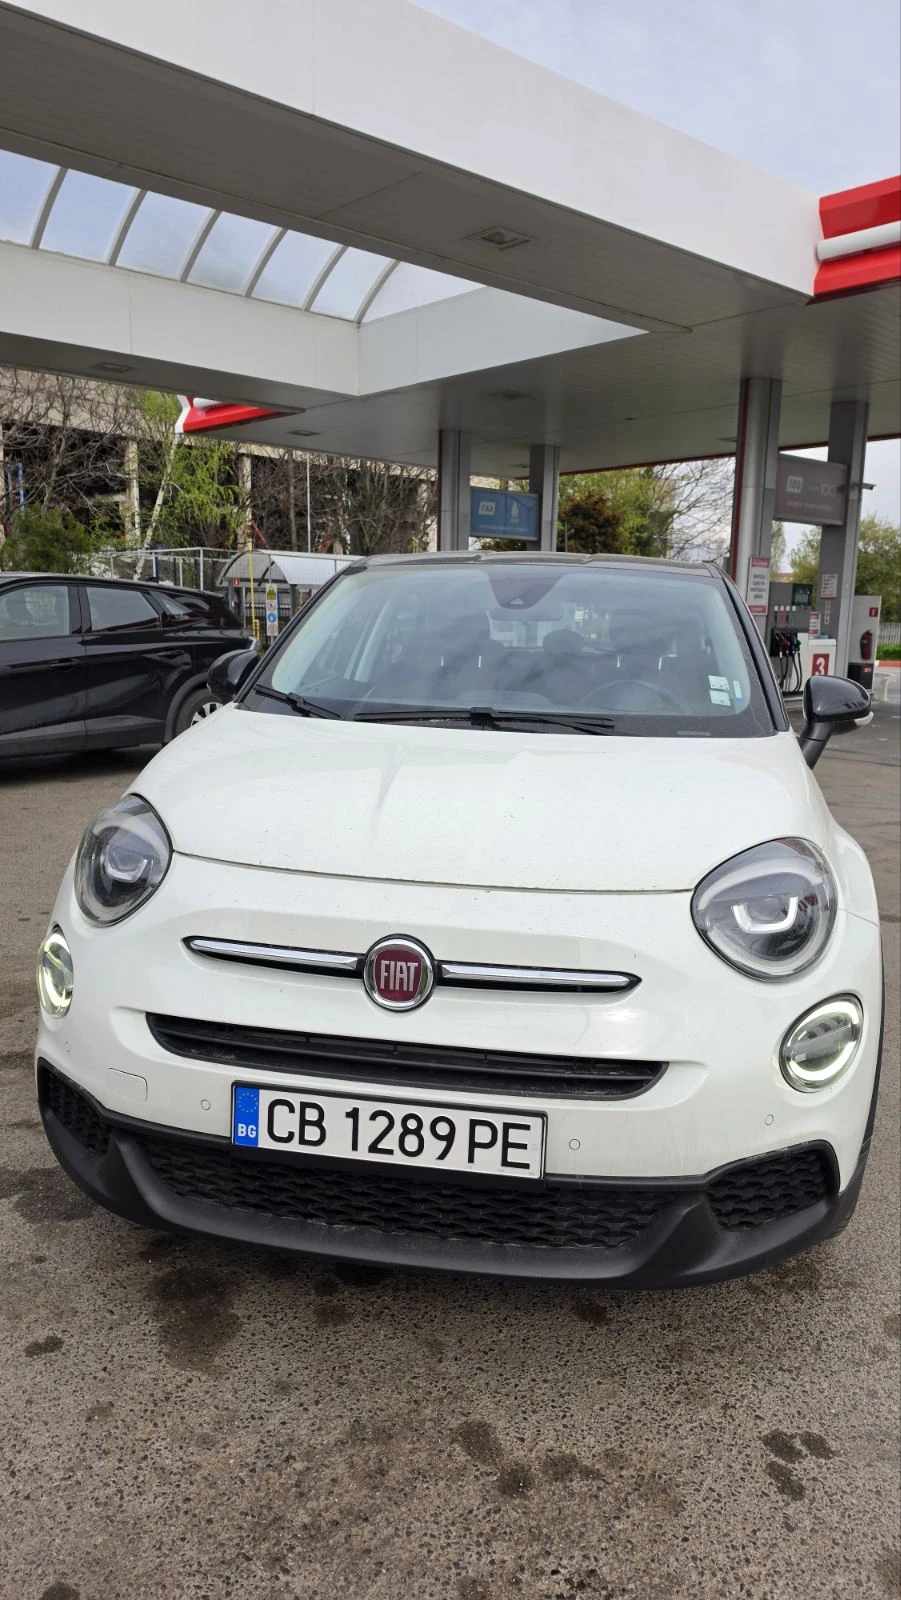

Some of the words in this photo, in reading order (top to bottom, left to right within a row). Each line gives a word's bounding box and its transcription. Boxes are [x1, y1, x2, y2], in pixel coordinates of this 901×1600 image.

[815, 657, 826, 676] 3
[380, 960, 419, 991] FIAT
[237, 1123, 257, 1138] BG
[267, 1098, 327, 1147] CB
[345, 1107, 456, 1160] 1289
[467, 1118, 531, 1169] PE
